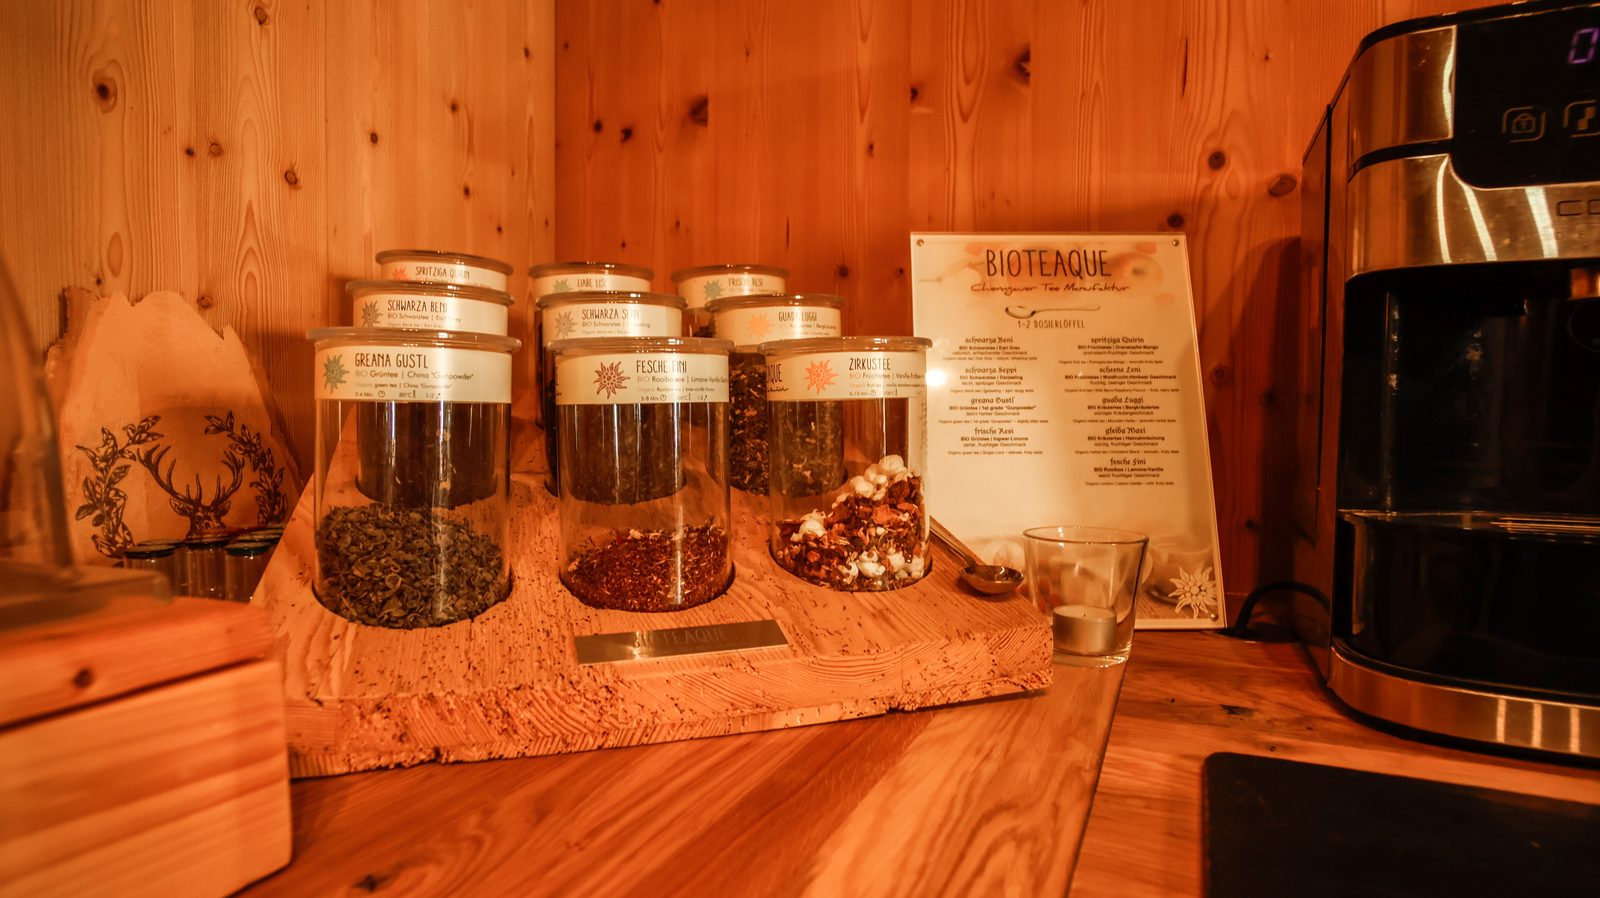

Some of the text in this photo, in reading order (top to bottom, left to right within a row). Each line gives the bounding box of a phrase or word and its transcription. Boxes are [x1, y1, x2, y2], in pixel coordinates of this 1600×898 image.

[986, 249, 1112, 280] BIOTEAQUE
[415, 266, 447, 277] SPRITZIGA
[595, 278, 606, 288] LIS
[1042, 284, 1060, 292] Tee
[1063, 283, 1130, 292] Manufaktur
[387, 300, 447, 313] SCHWARZA BENI
[582, 309, 619, 320] SCHWARZA
[779, 311, 799, 322] GUAD
[1018, 319, 1085, 329] 1-2 DOSIERLÖFFEL
[355, 353, 428, 368] GREANA GUSTL
[849, 358, 891, 371] ZIRKUSTEE
[636, 360, 667, 373] FESCHE
[370, 370, 398, 378] Grüntee
[407, 371, 429, 379] China
